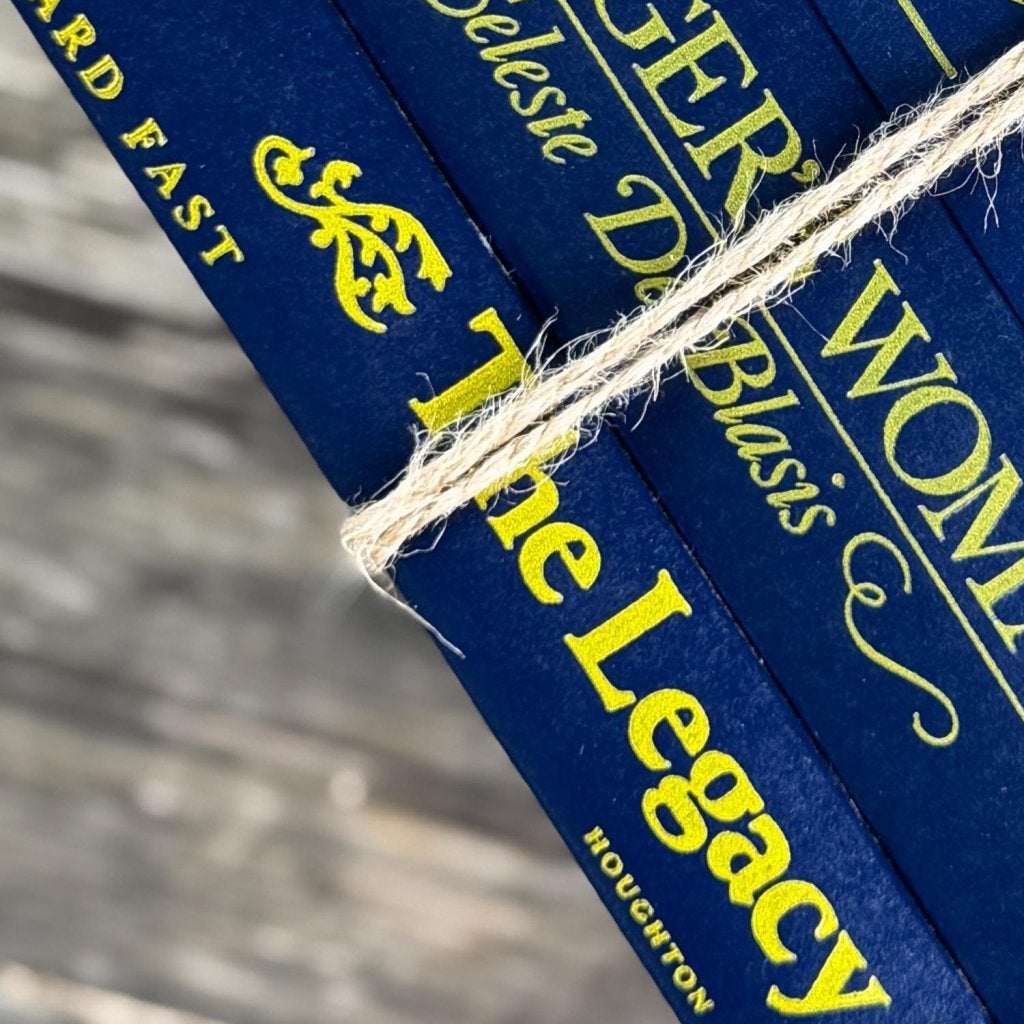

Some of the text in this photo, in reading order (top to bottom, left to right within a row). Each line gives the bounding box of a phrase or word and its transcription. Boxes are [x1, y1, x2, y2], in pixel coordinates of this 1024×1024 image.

[120, 116, 246, 267] FAST
[683, 316, 847, 537] Blasis
[408, 307, 893, 1018] The Legacy
[583, 825, 716, 1015] HOUGHTON
